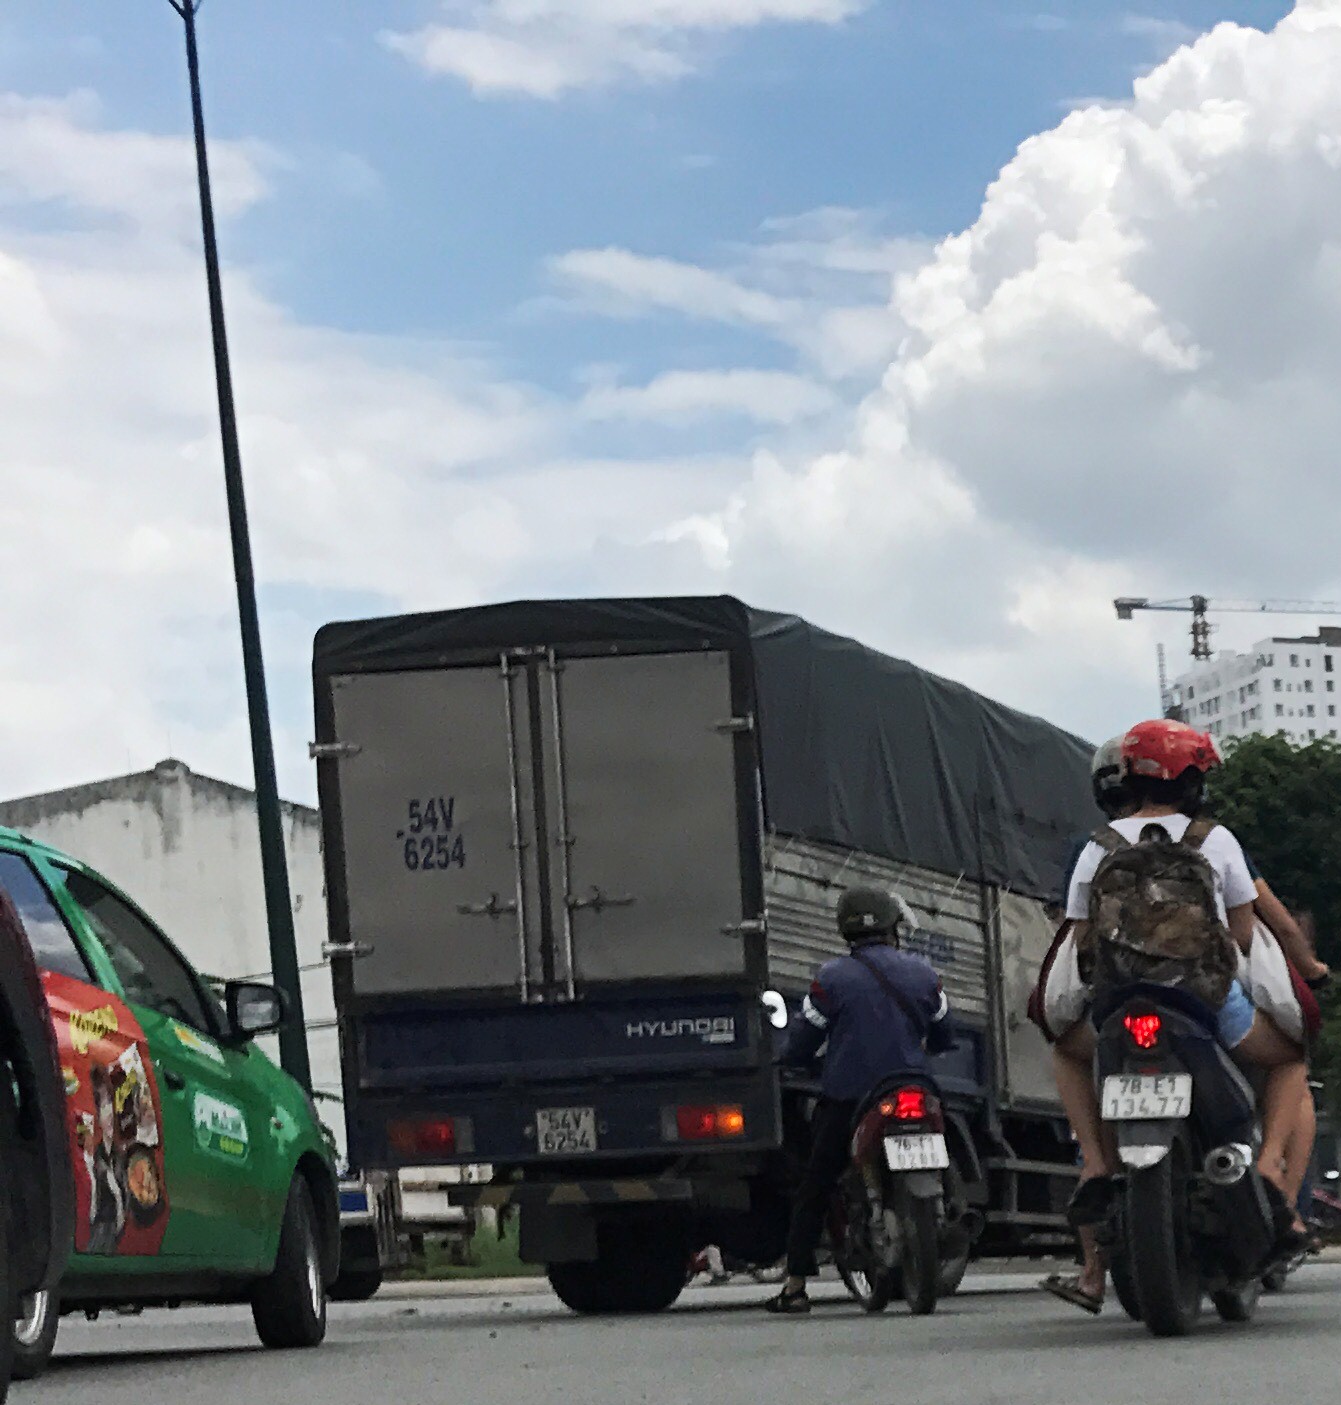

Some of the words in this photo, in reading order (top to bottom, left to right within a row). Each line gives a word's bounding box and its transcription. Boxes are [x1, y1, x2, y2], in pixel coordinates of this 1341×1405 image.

[408, 796, 454, 833] 54V
[404, 834, 466, 870] 6254
[626, 1017, 735, 1038] HYUNDAI
